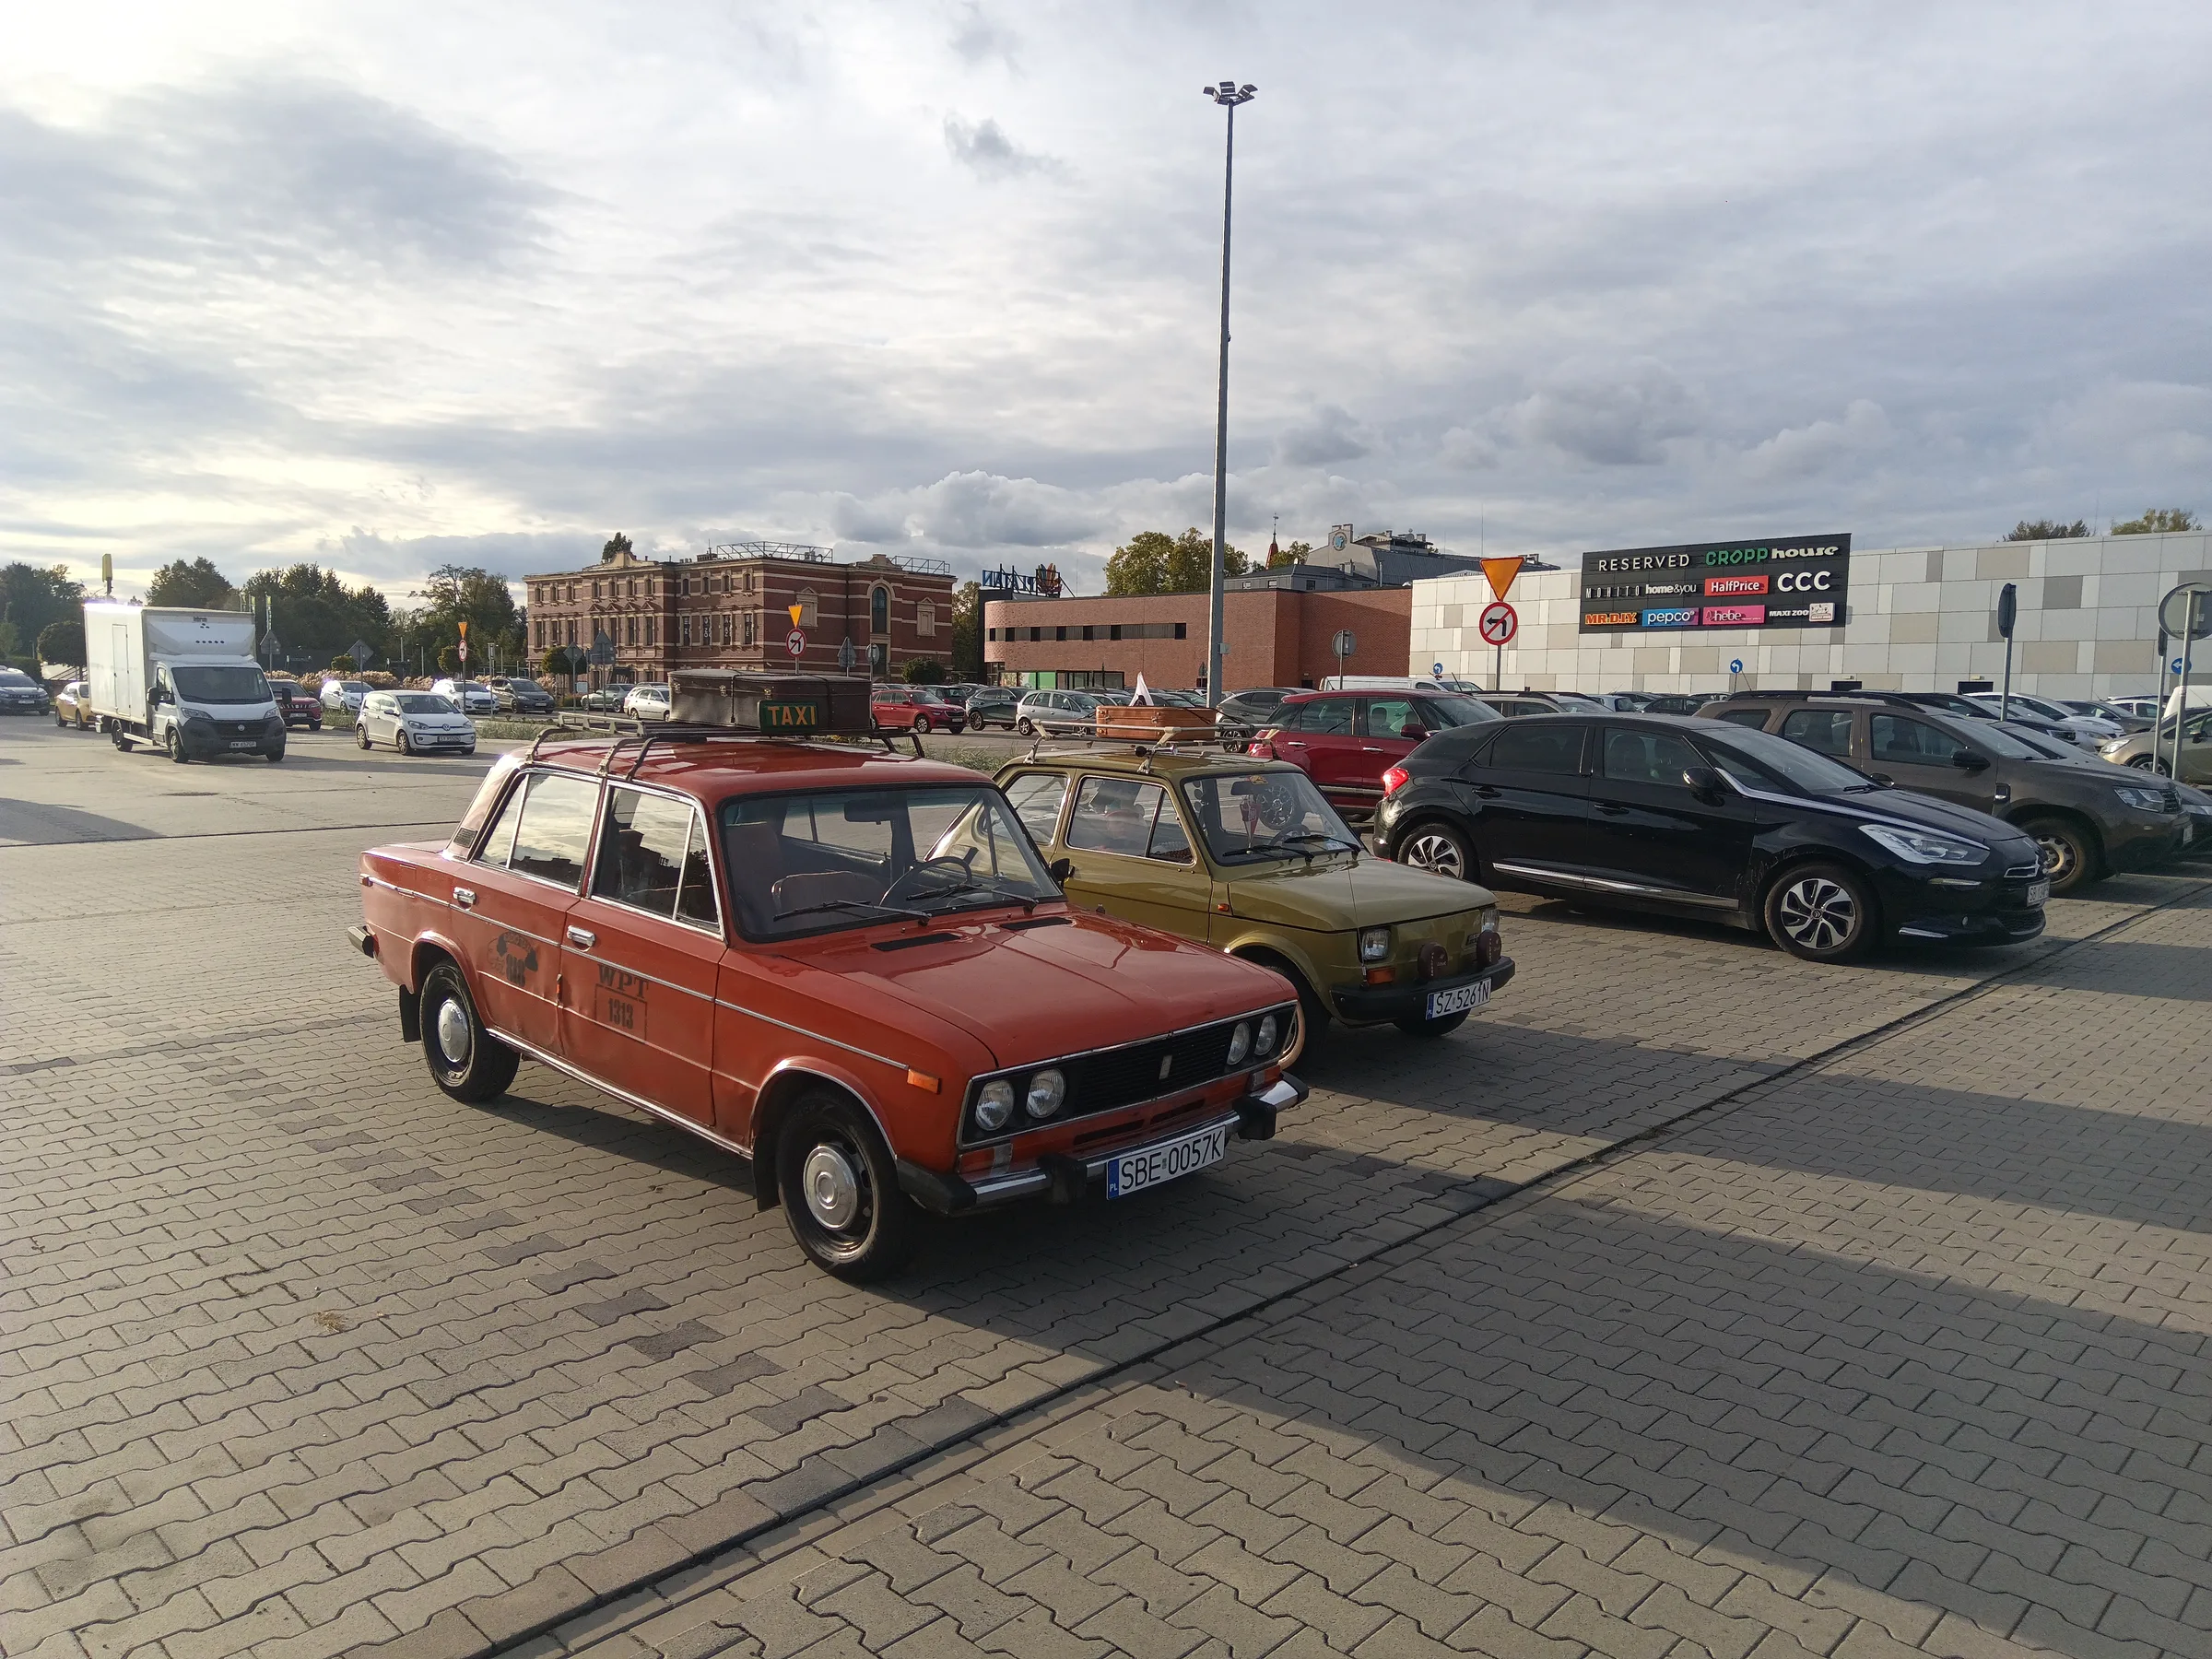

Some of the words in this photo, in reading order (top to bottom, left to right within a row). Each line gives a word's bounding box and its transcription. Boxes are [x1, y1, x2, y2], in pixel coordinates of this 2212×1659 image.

[1705, 547, 1768, 566] CROPP
[1771, 546, 1839, 559] house
[1598, 554, 1689, 571] RESERVED
[1645, 583, 1696, 595] home&you
[1711, 580, 1760, 593] HalfPrice
[1777, 571, 1831, 592] CCC
[1585, 585, 1640, 599] MOHITO
[1714, 609, 1742, 622] hebe
[768, 706, 816, 726] TAXI
[597, 963, 649, 998] WPT
[1436, 992, 1453, 1014] SZ
[1456, 982, 1489, 1009] 5261N
[608, 997, 634, 1030] 1313
[1121, 1152, 1161, 1189] SBE
[1168, 1131, 1223, 1175] 0057K
[1109, 1183, 1118, 1192] PL
